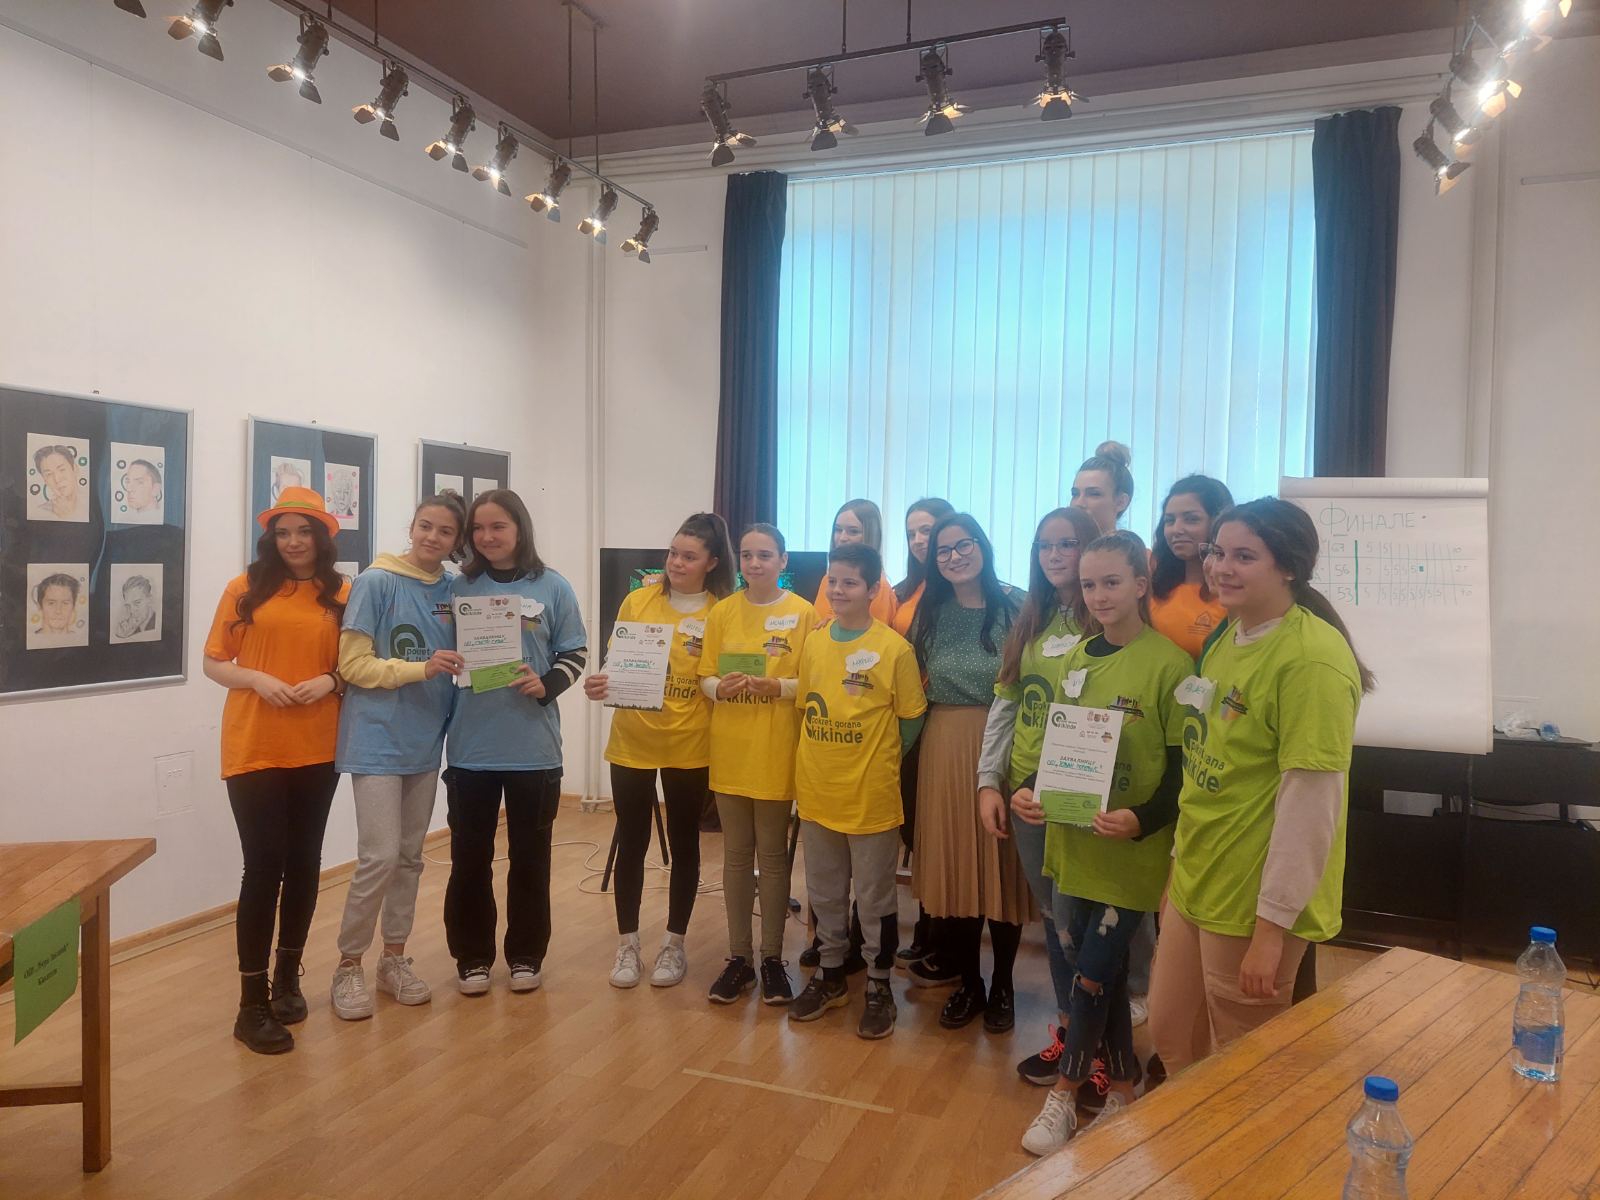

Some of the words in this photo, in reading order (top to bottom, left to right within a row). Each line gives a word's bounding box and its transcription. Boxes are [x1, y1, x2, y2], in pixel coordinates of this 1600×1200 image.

[1319, 501, 1416, 535] ФИНАЛЕ
[1335, 564, 1350, 577] 56
[1337, 587, 1353, 602] 53
[834, 720, 862, 729] gorana
[811, 726, 864, 744] kikinde
